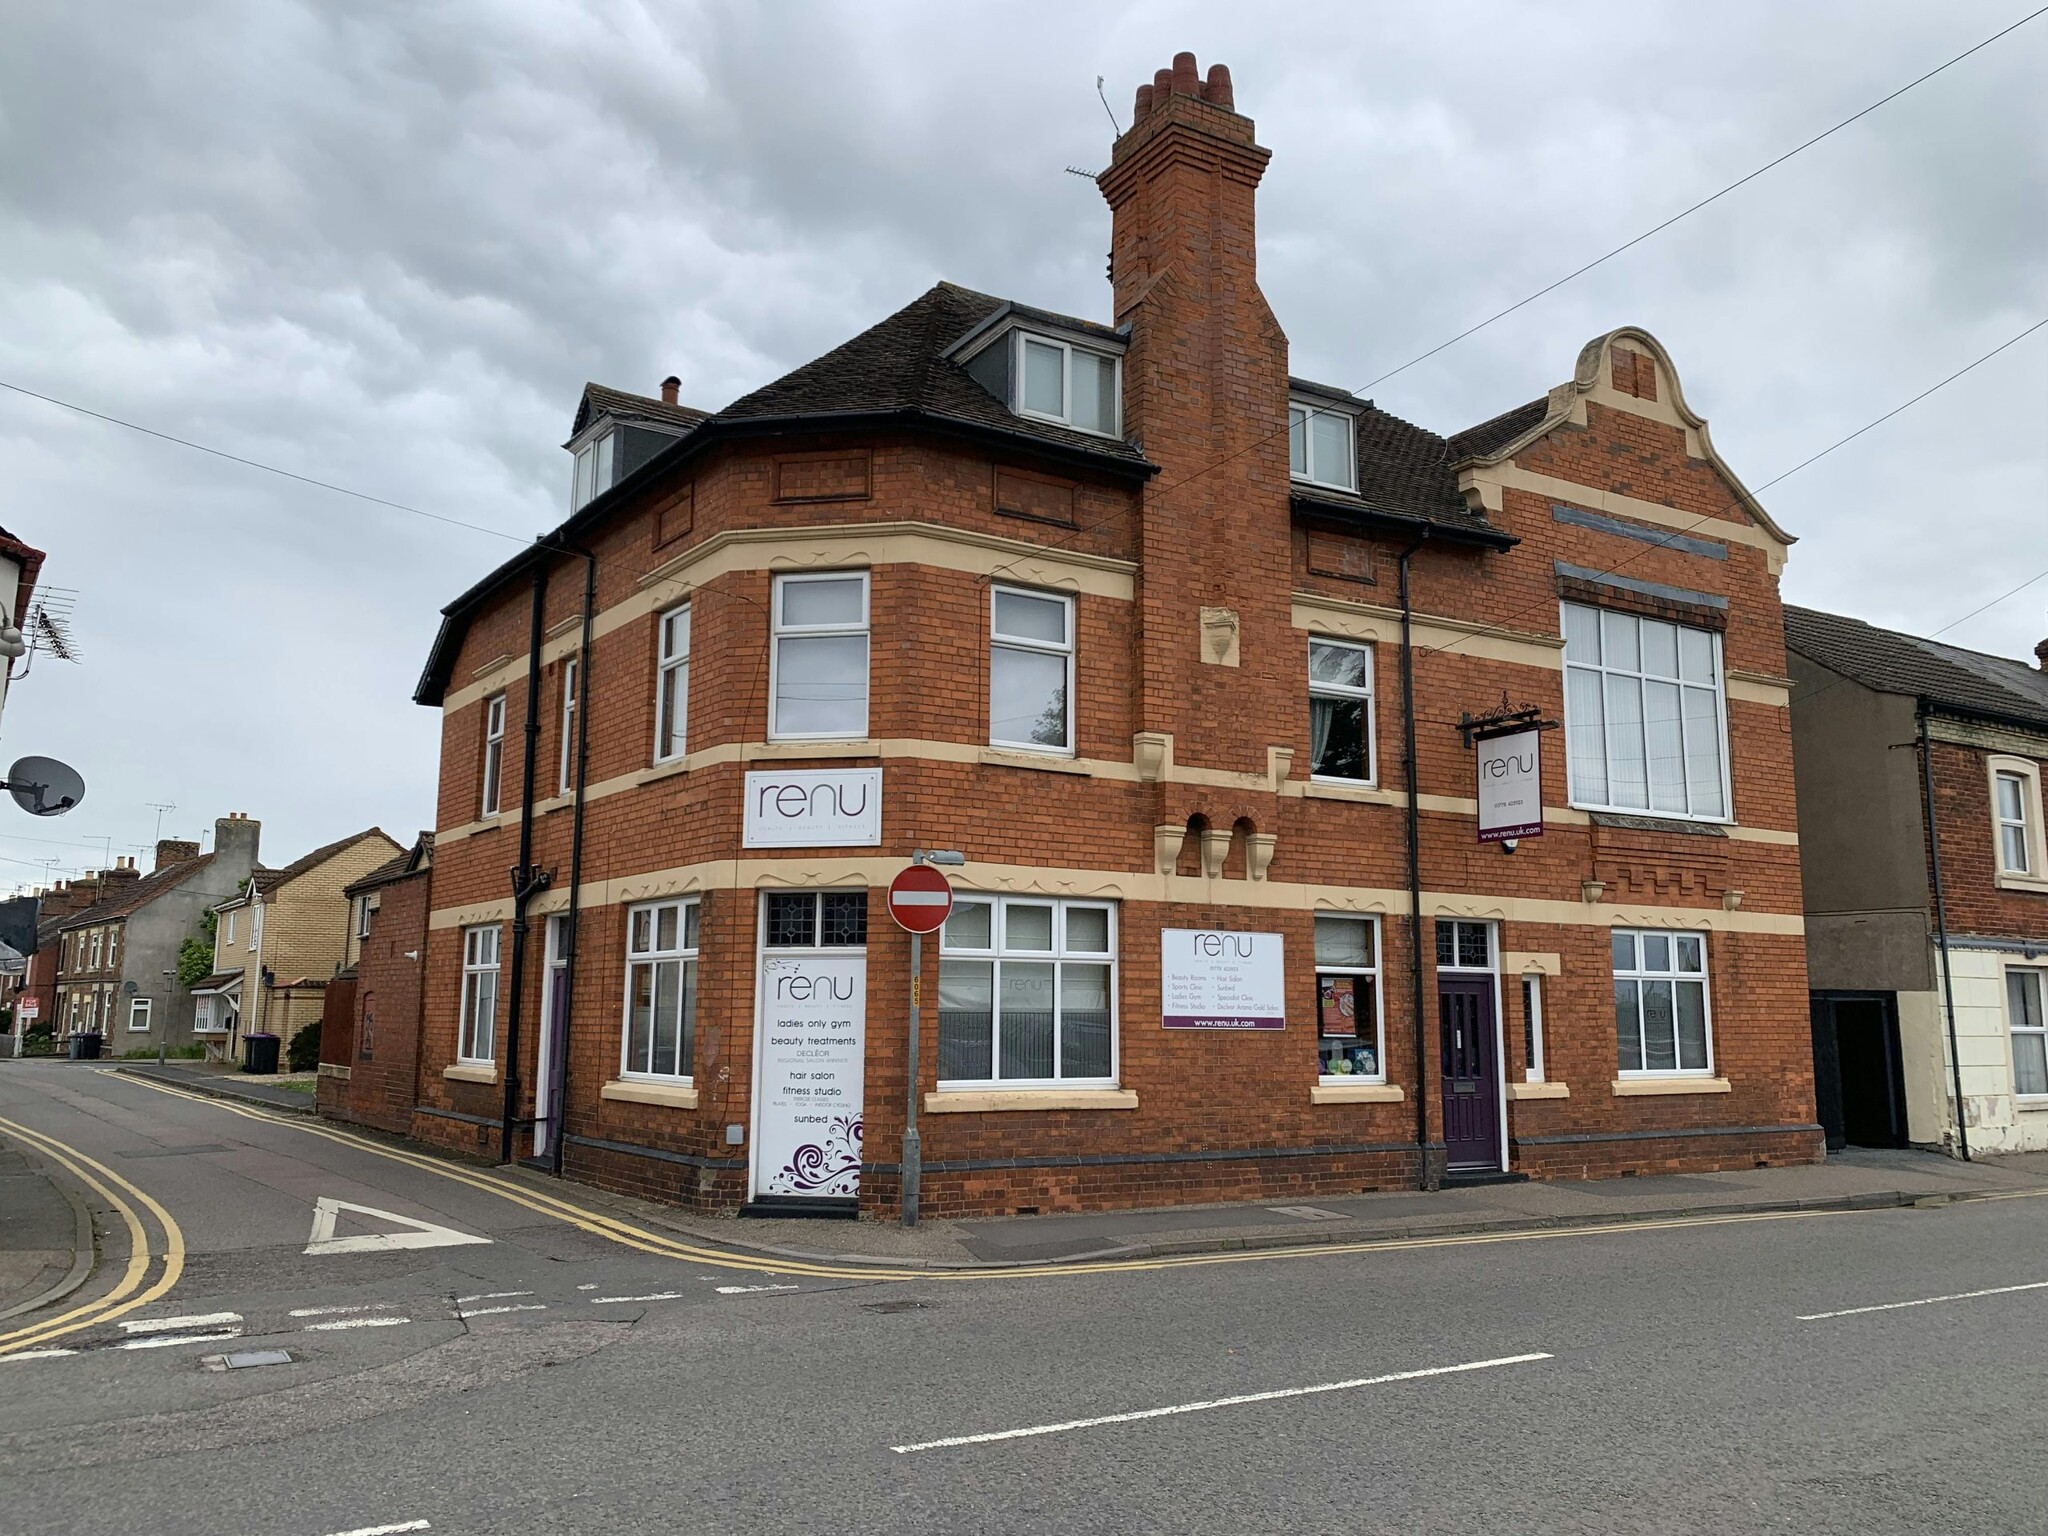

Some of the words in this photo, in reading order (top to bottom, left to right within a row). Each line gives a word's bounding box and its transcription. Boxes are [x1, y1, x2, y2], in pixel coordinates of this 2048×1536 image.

[1483, 753, 1533, 780] renu
[759, 783, 867, 818] renu
[1481, 826, 1541, 839] www.renu.uk.com
[1194, 933, 1253, 958] renu
[778, 976, 853, 1001] renu
[1171, 983, 1188, 991] Sports
[777, 1019, 804, 1027] ladies
[807, 1019, 827, 1029] only
[830, 1020, 851, 1029] gym
[1194, 1018, 1255, 1028] www.renu.uk.com
[771, 1037, 804, 1047] beauty
[807, 1037, 857, 1046] treatments
[789, 1071, 807, 1080] hair
[810, 1071, 835, 1080] salon
[782, 1086, 811, 1095] fitness
[814, 1086, 842, 1096] studio
[794, 1115, 828, 1123] sunbed
